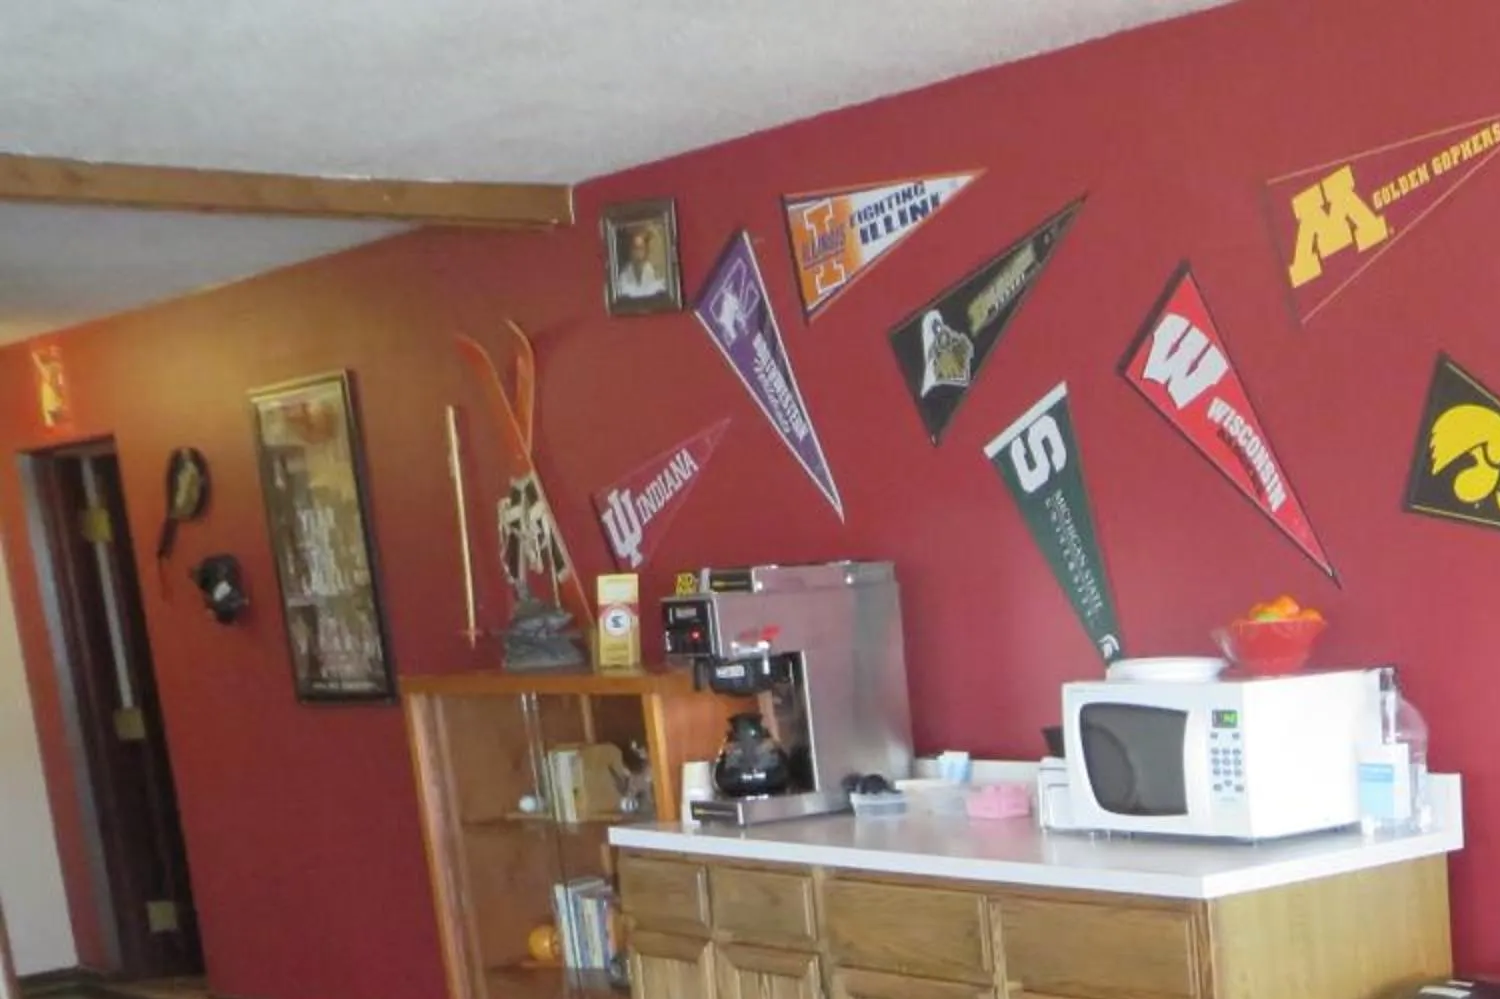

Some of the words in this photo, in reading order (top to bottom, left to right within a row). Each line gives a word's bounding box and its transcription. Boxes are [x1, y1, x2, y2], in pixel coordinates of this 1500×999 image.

[1288, 164, 1388, 288] M
[1371, 161, 1430, 210] GOLDEN
[1143, 313, 1229, 409] W
[636, 447, 700, 525] INDIANA
[1011, 414, 1068, 493] S
[1206, 397, 1288, 512] WISCONSIN
